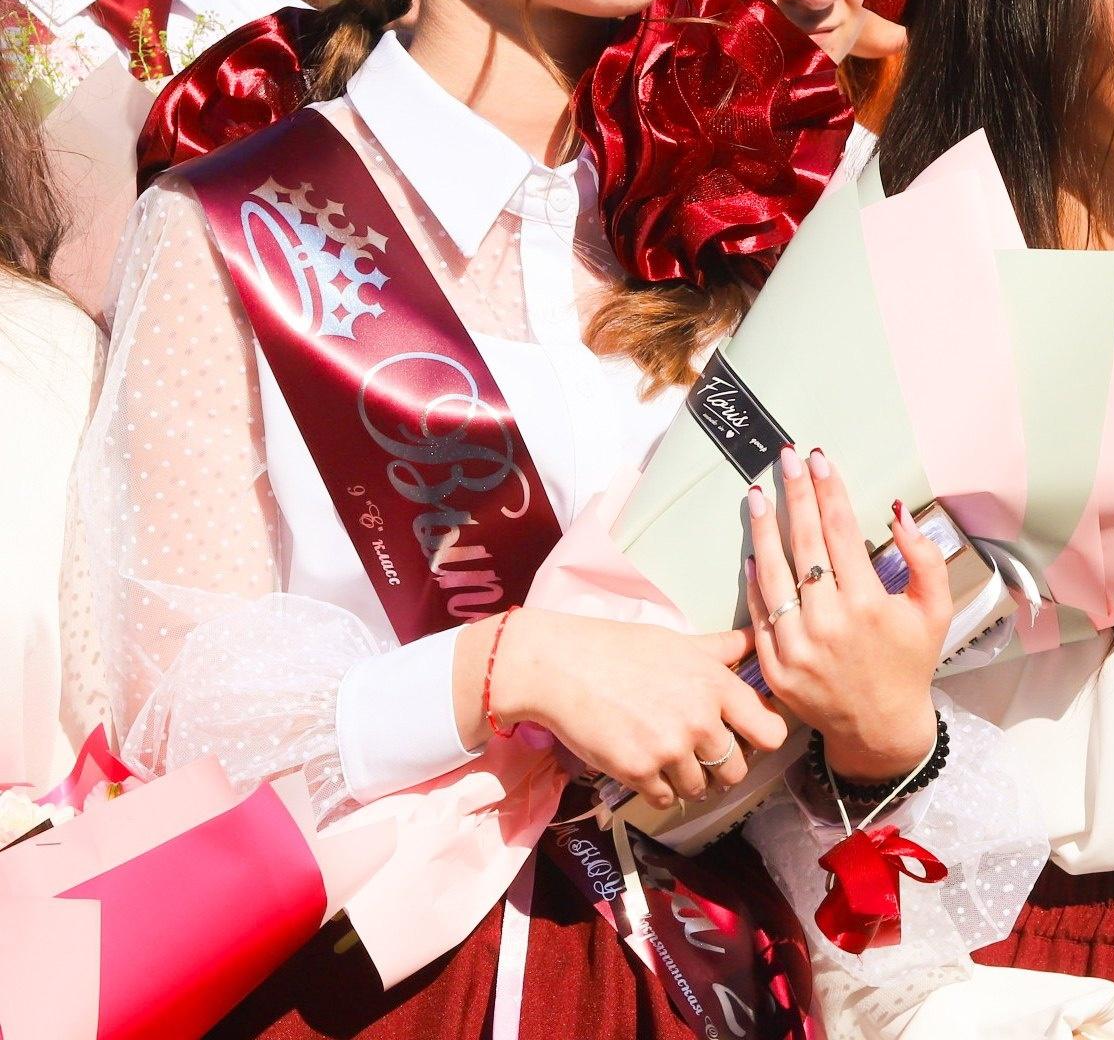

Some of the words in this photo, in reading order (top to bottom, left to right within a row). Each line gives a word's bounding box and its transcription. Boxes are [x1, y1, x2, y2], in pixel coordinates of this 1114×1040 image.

[347, 485, 366, 497] 9
[372, 539, 400, 586] класс
[358, 351, 530, 622] Вып
